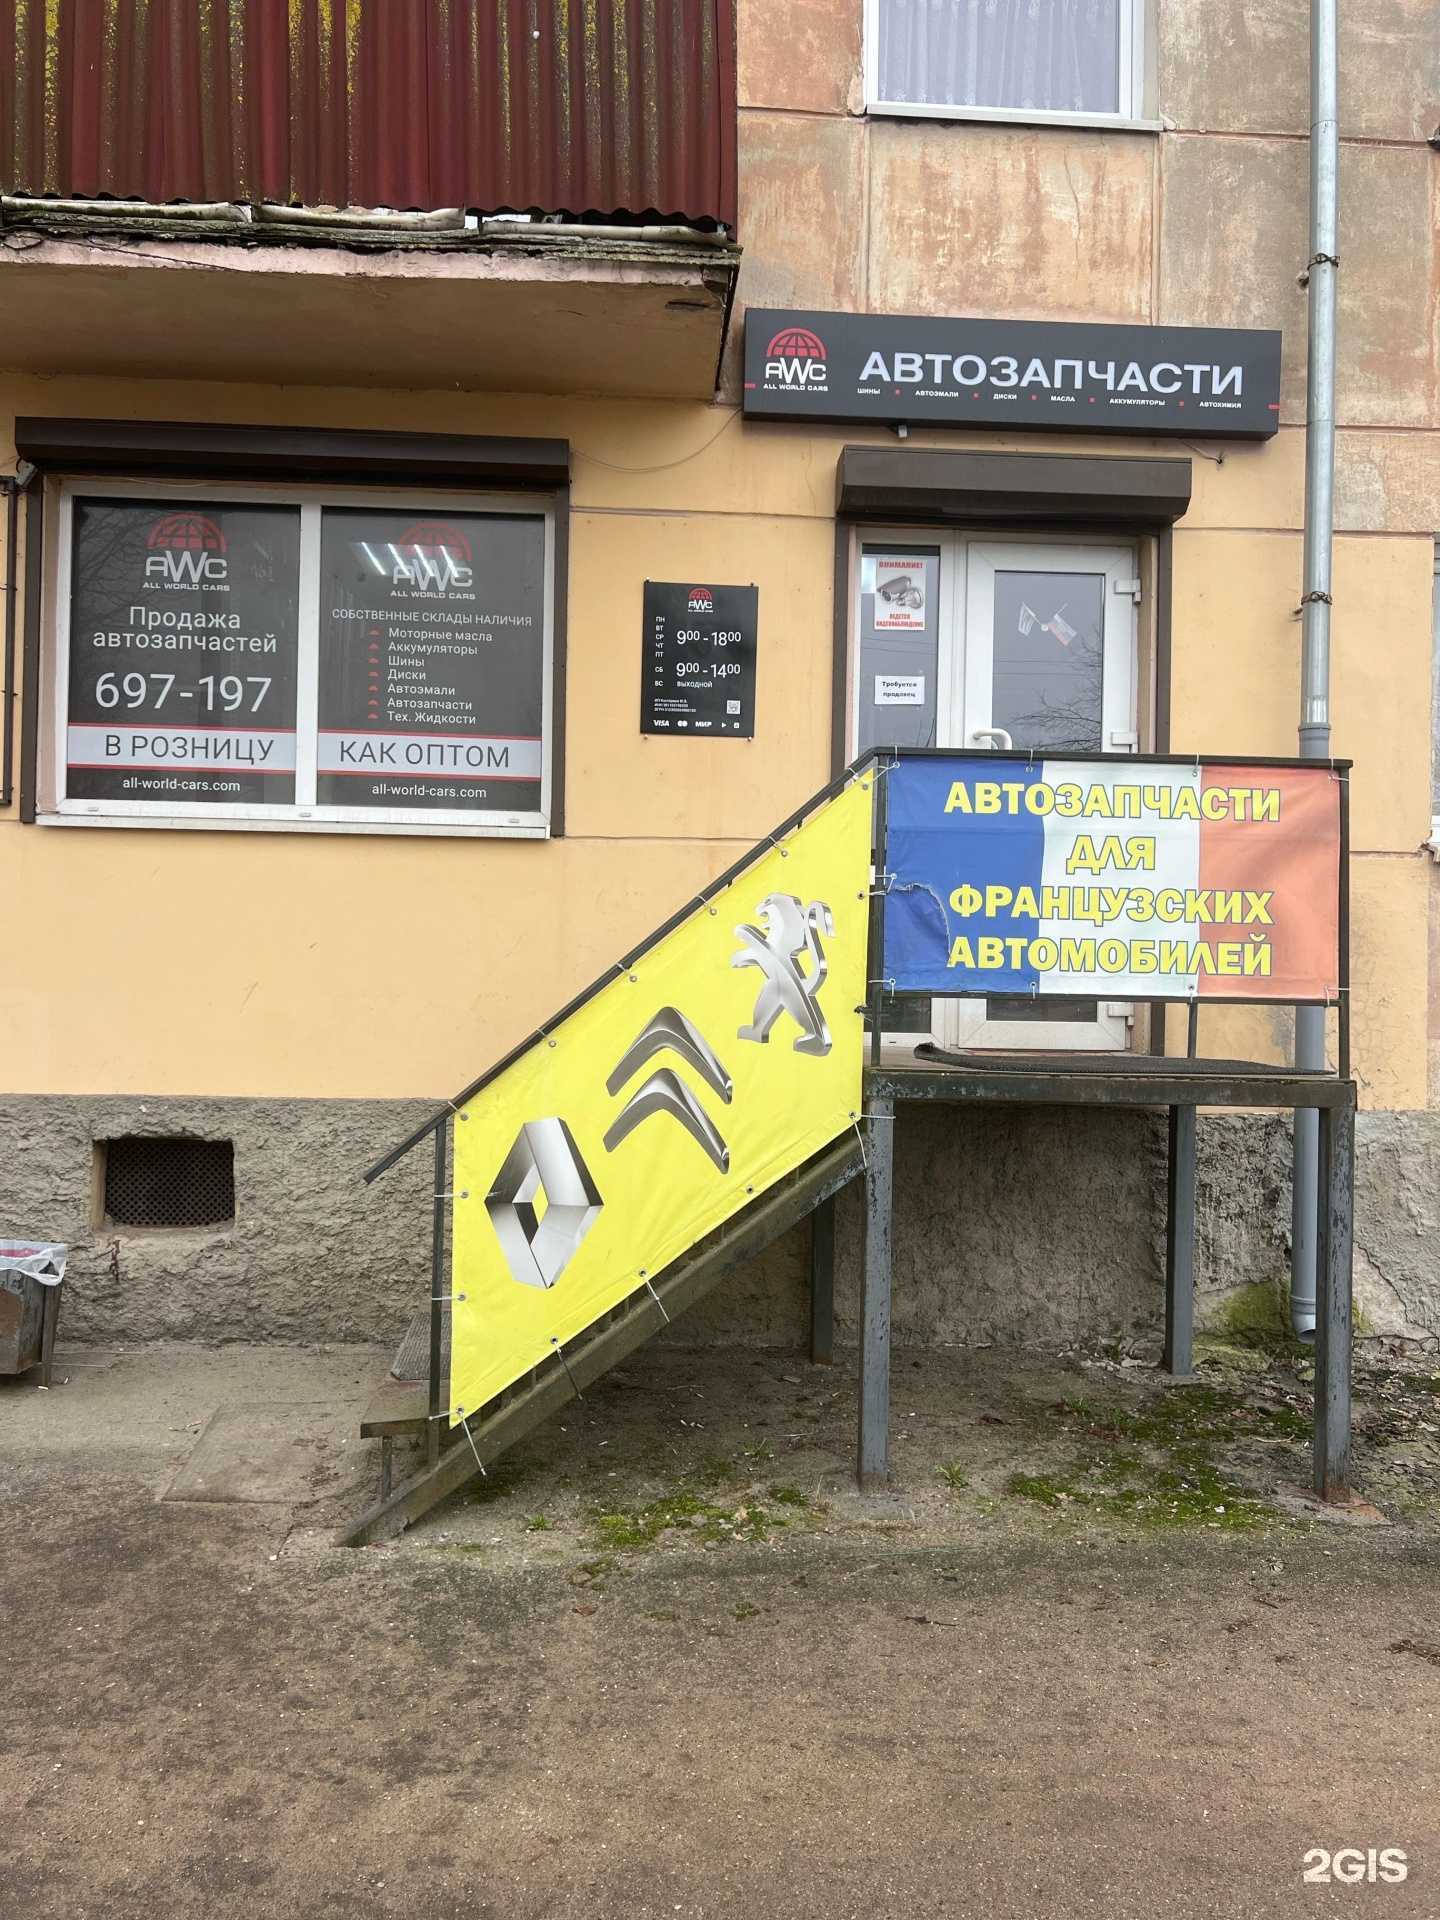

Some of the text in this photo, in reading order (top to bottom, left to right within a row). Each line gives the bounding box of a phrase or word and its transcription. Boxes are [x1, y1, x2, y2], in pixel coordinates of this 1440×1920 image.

[764, 357, 827, 385] AWC
[858, 351, 1243, 396] АВТОЗАПЧАСТИ
[857, 387, 1242, 409] ШИНЫ АВТОЭМАЛИ ДИСКИ МАСЛА АККУМУЛЯТОРЫ АВТОХИМИЯ
[145, 550, 228, 583] AWC
[392, 558, 473, 592] AWC
[142, 582, 231, 592] ALL WORLD CARS
[390, 589, 476, 600] ALL WORLD CARS
[688, 599, 713, 610] AWC
[129, 606, 241, 630] Продажа
[331, 608, 533, 627] СОБСТВЕННЫЕ СКЛАДЫ НАЛИЧИЯ
[92, 631, 277, 653] автозапчастей
[388, 628, 493, 642] Моторные масла
[388, 642, 478, 656] Аккумуляторы
[388, 656, 425, 667] Шины
[387, 669, 426, 681] Диски
[95, 671, 273, 713] 697-197
[387, 683, 456, 696] Автоэмали
[387, 697, 473, 711] Автозапчасти
[387, 710, 476, 725] Тех. Жидкости
[105, 734, 275, 766] В РОЗНИЦУ
[339, 740, 510, 769] КАК ОПТОМ
[122, 776, 241, 792] all-world-cars.com
[371, 783, 488, 799] all-world-cars.com
[943, 781, 1281, 823] АВТОЗАПЧАСТИ
[1065, 834, 1157, 876] ДЛЯ
[948, 883, 1275, 928] ФРАНЦУЗСКИХ
[946, 932, 1272, 977] АВТОМОБИЛЕЙ
